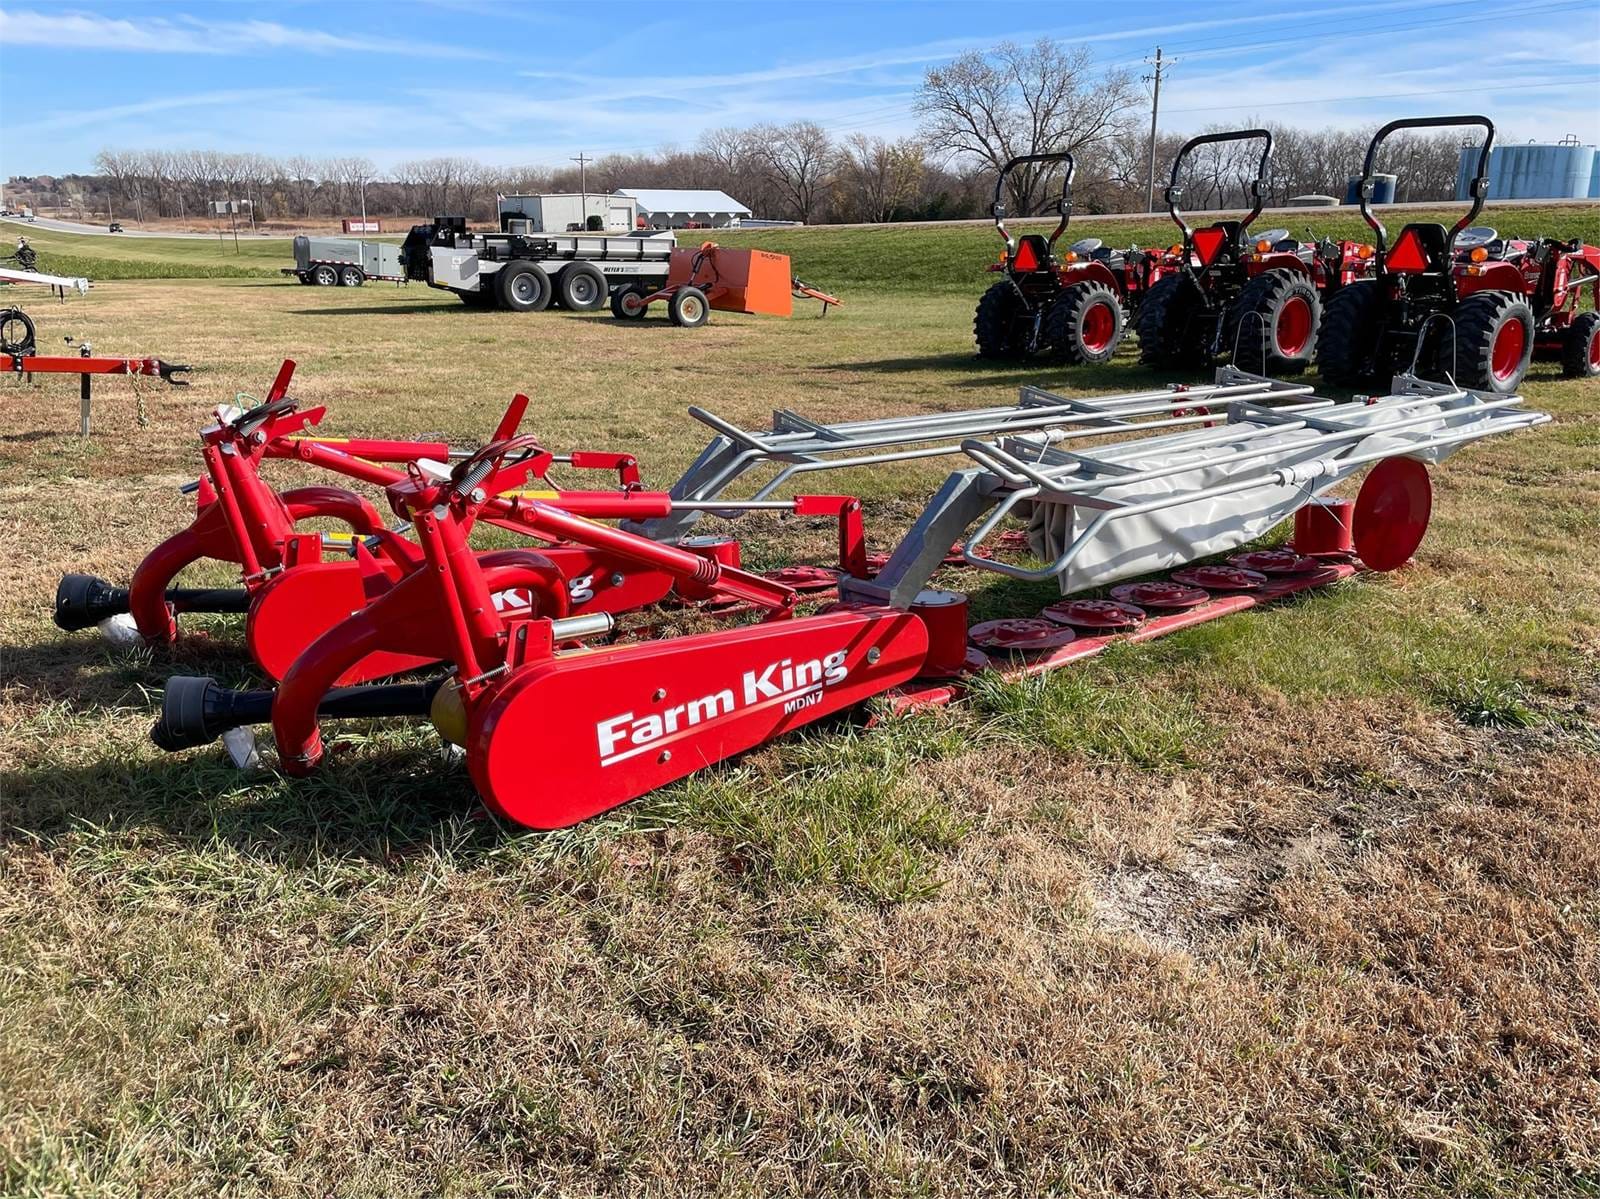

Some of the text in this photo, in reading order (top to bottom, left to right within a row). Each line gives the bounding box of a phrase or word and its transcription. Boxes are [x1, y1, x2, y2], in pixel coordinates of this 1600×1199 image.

[490, 575, 594, 609] Kg
[597, 649, 848, 758] Farm King
[784, 690, 824, 716] MDN7
